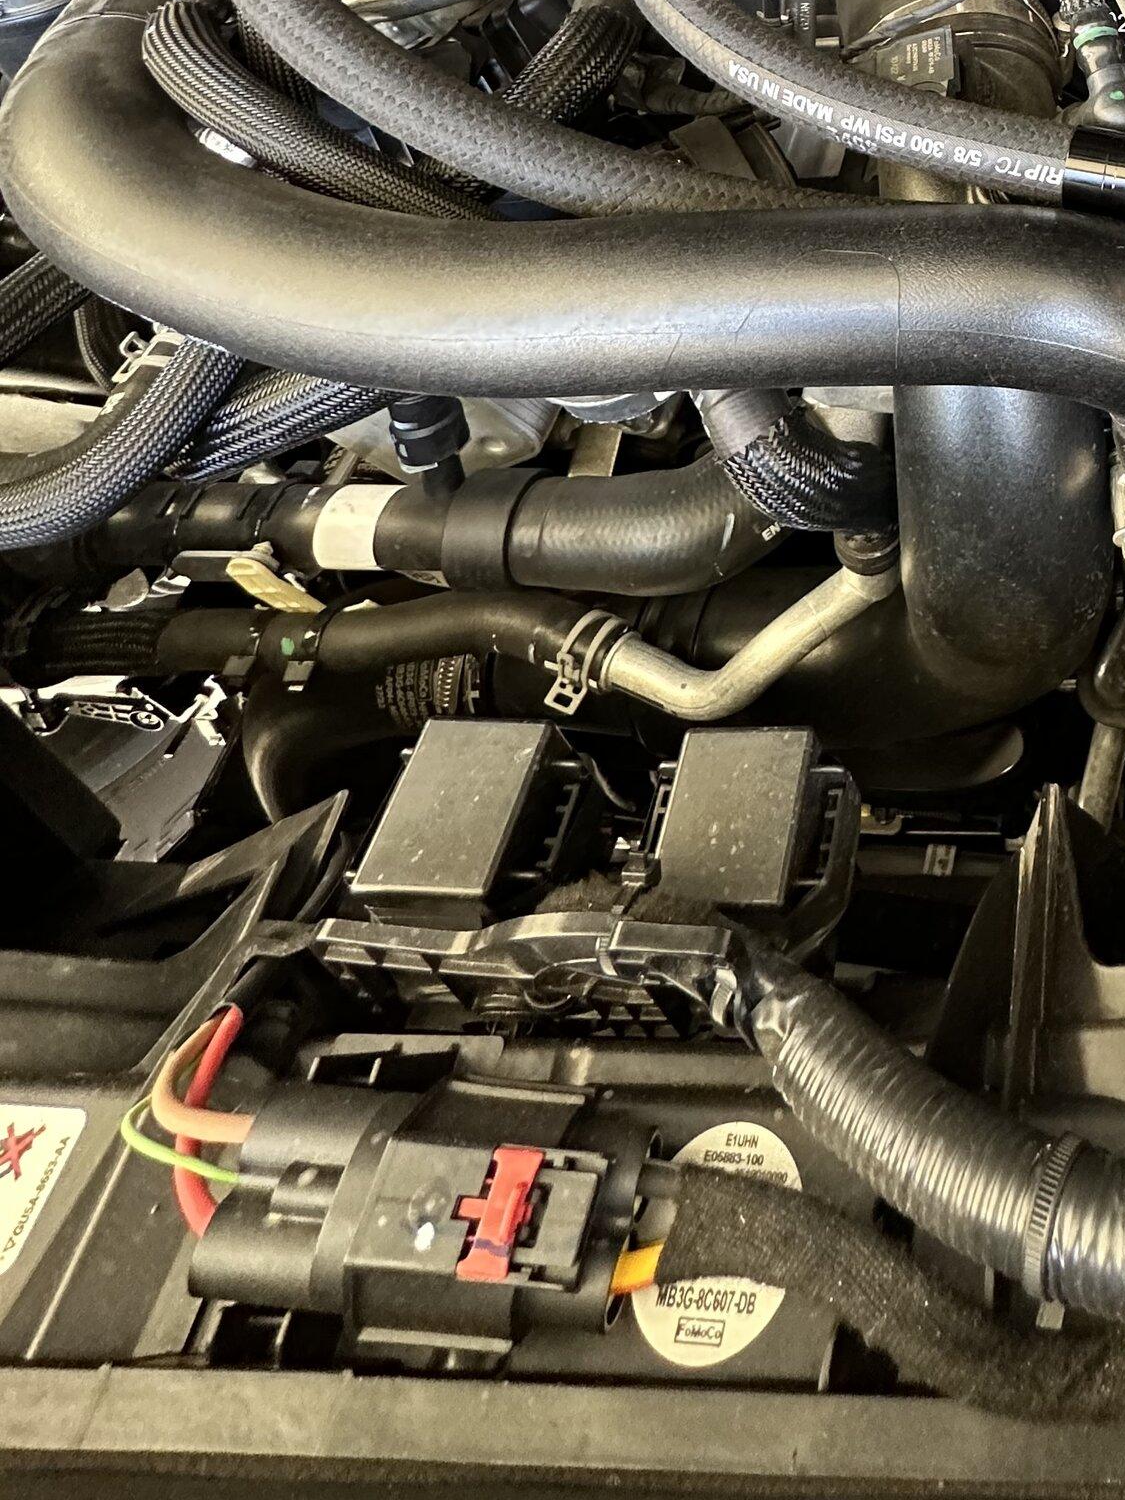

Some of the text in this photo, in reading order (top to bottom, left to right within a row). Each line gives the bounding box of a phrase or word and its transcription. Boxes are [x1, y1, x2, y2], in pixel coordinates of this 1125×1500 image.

[728, 60, 760, 84] USA
[761, 80, 780, 100] IN
[782, 90, 834, 123] MADE
[841, 115, 872, 135] WP
[874, 123, 906, 148] PSI
[910, 134, 946, 158] 300
[954, 147, 983, 167] 5/8
[994, 156, 1024, 177] TC
[726, 1133, 759, 1148] E1UHN
[678, 1323, 722, 1341] FoMoCo
